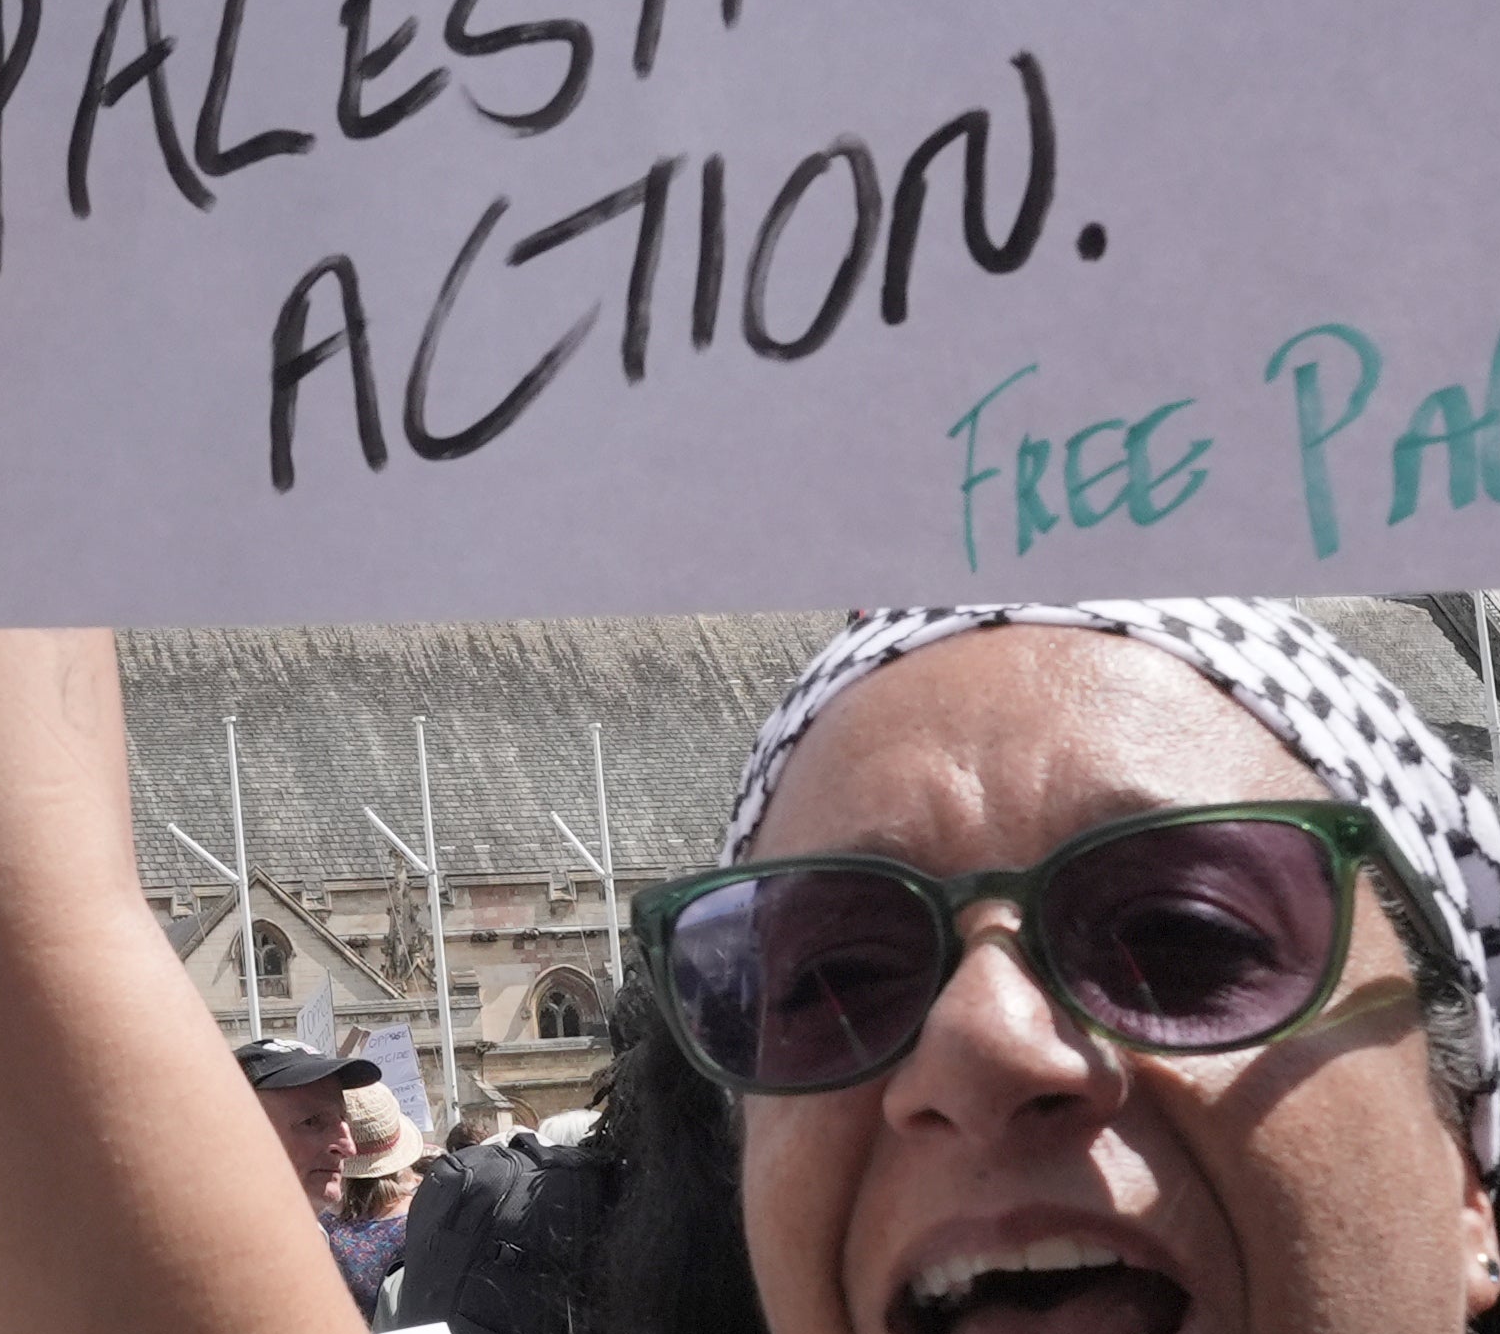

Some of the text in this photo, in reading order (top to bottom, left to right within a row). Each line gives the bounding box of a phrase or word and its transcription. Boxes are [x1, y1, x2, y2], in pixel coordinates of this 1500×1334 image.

[270, 51, 1107, 492] ACTION.
[948, 363, 1213, 573] FREE
[368, 1030, 408, 1048] OPPOSE
